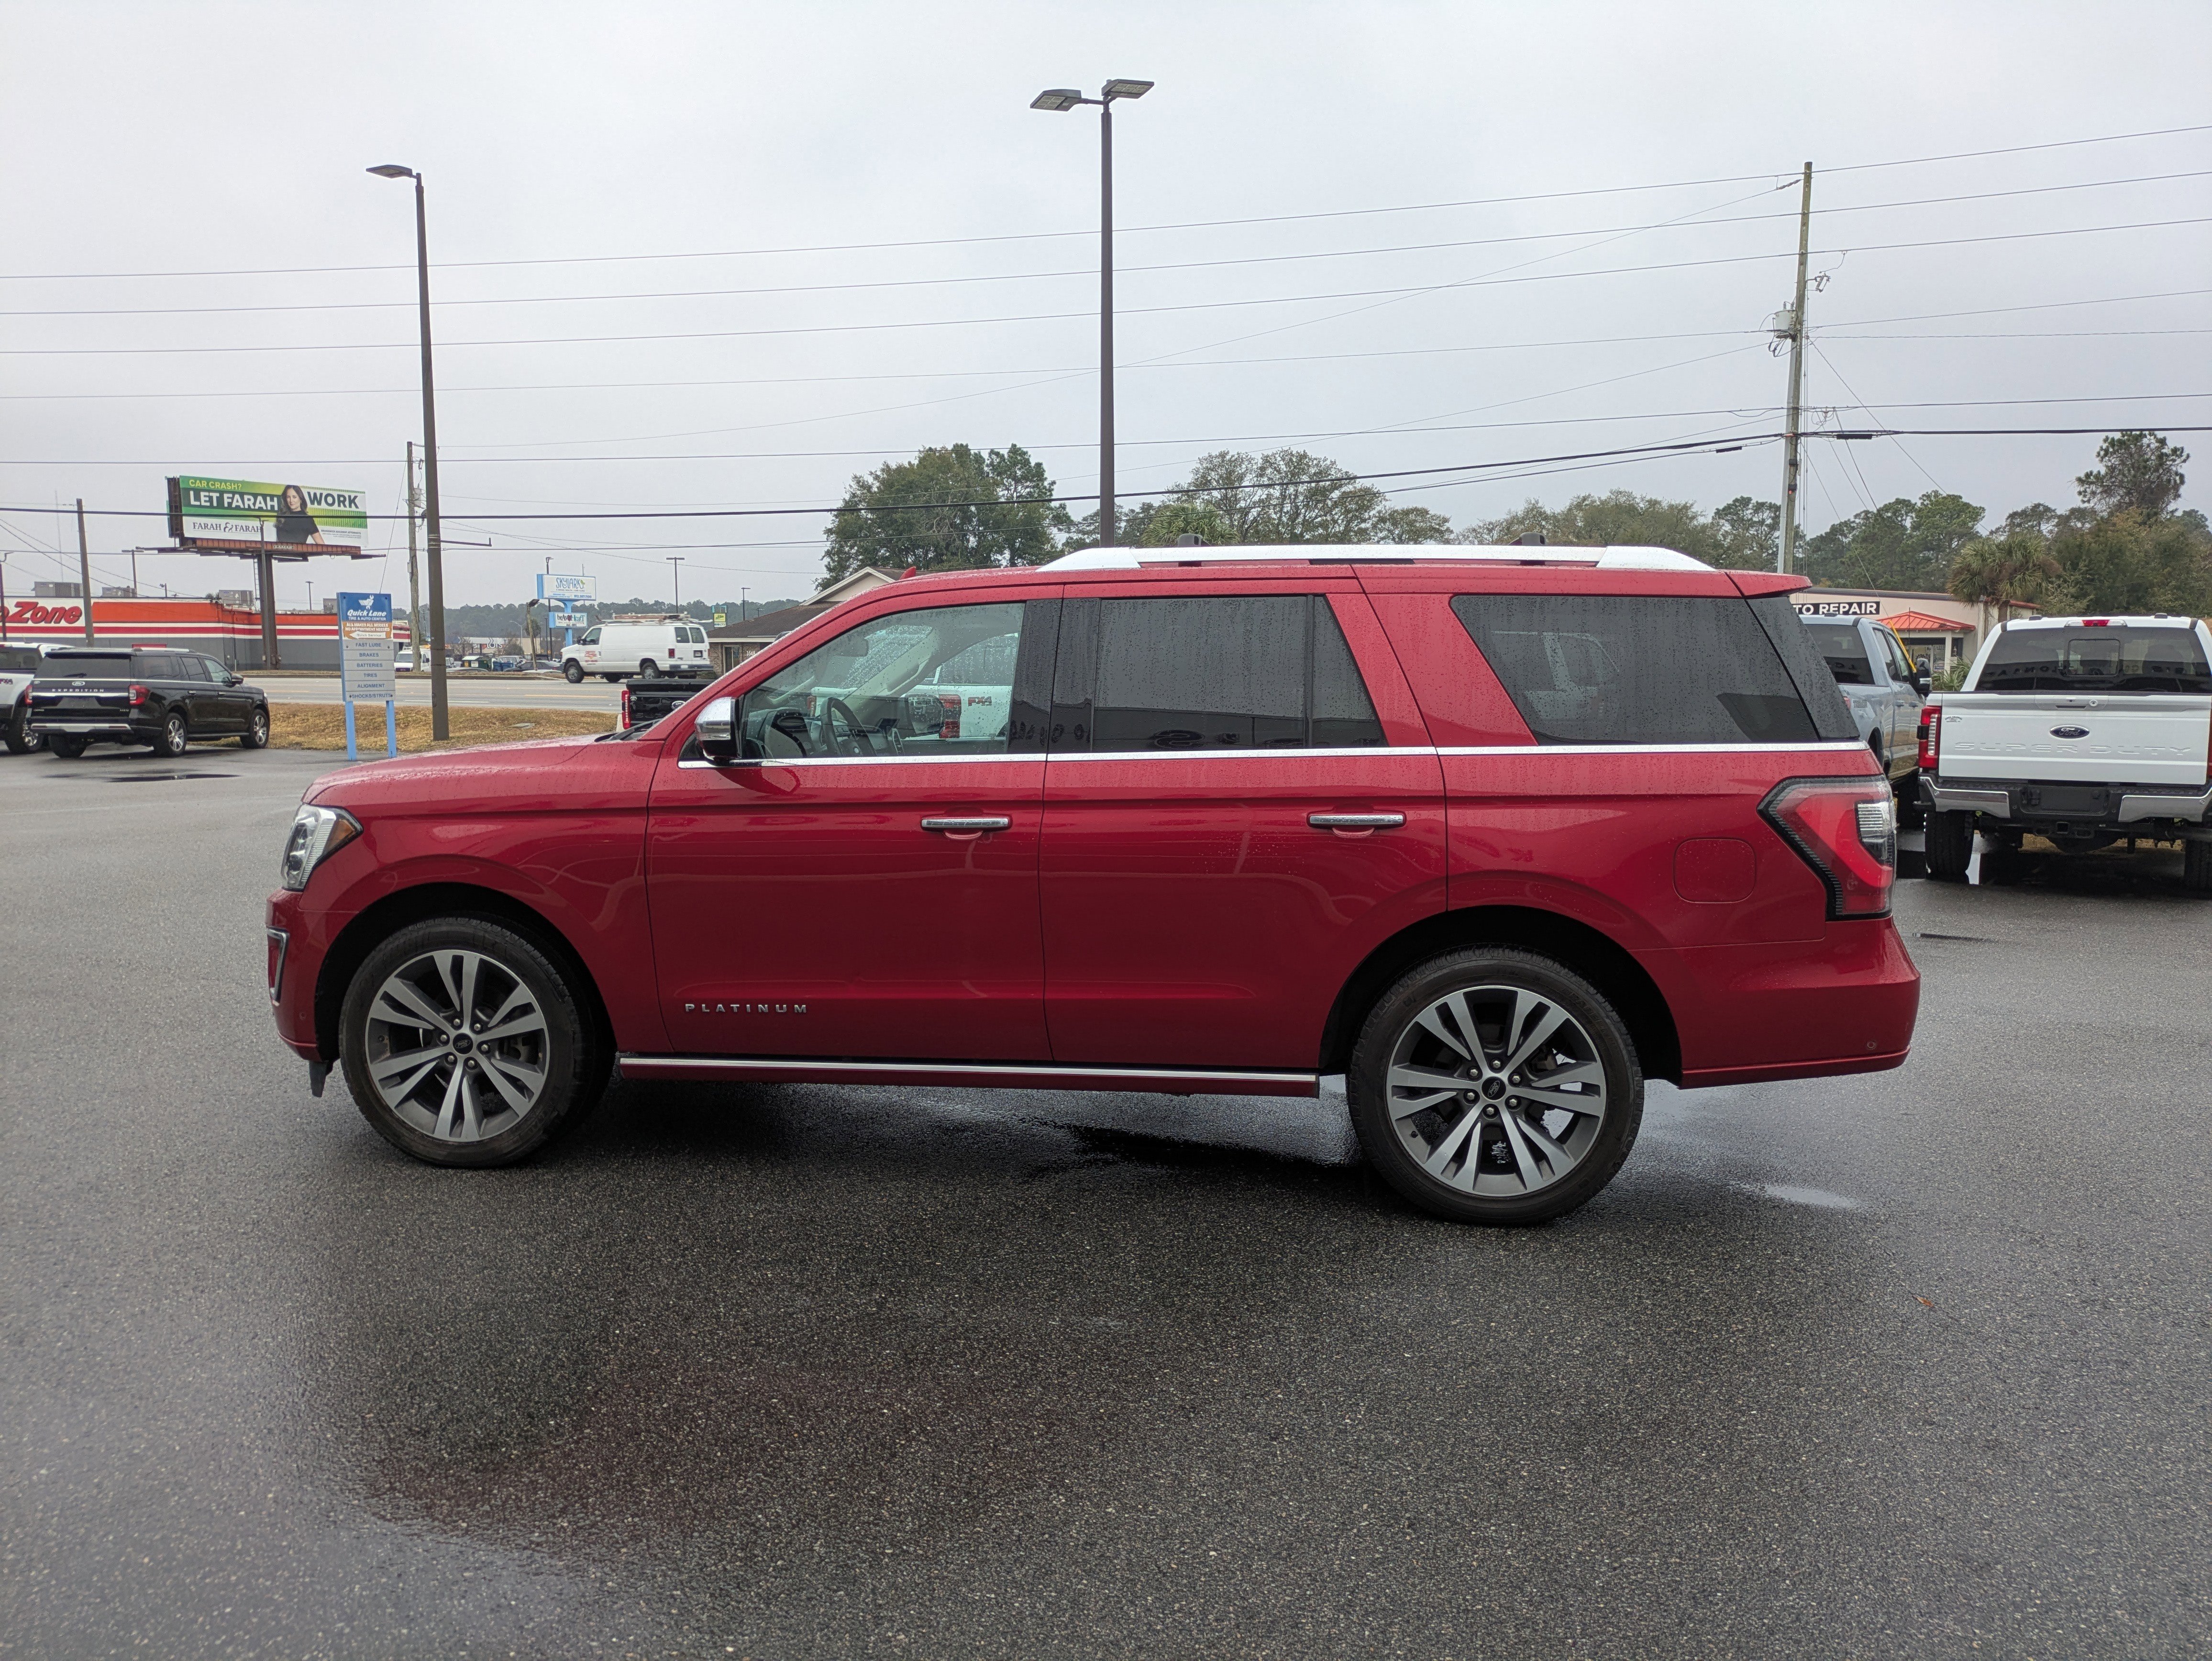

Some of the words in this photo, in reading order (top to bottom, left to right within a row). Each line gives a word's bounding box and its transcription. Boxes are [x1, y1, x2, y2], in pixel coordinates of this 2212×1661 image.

[189, 479, 207, 487] CAR
[209, 481, 242, 490] CRASH?
[190, 491, 220, 507] LET
[223, 493, 278, 510] FARAH
[307, 491, 359, 509] WORK
[192, 522, 221, 531] FARAH
[223, 522, 233, 532] &
[556, 577, 584, 589] SKYLARK
[1819, 603, 1877, 614] REPAIR
[968, 697, 992, 706] FX4
[2058, 728, 2080, 736] Ford
[1955, 742, 2078, 753] SUPER
[2090, 745, 2191, 755] DUTY
[685, 1004, 807, 1013] PLATINUM
